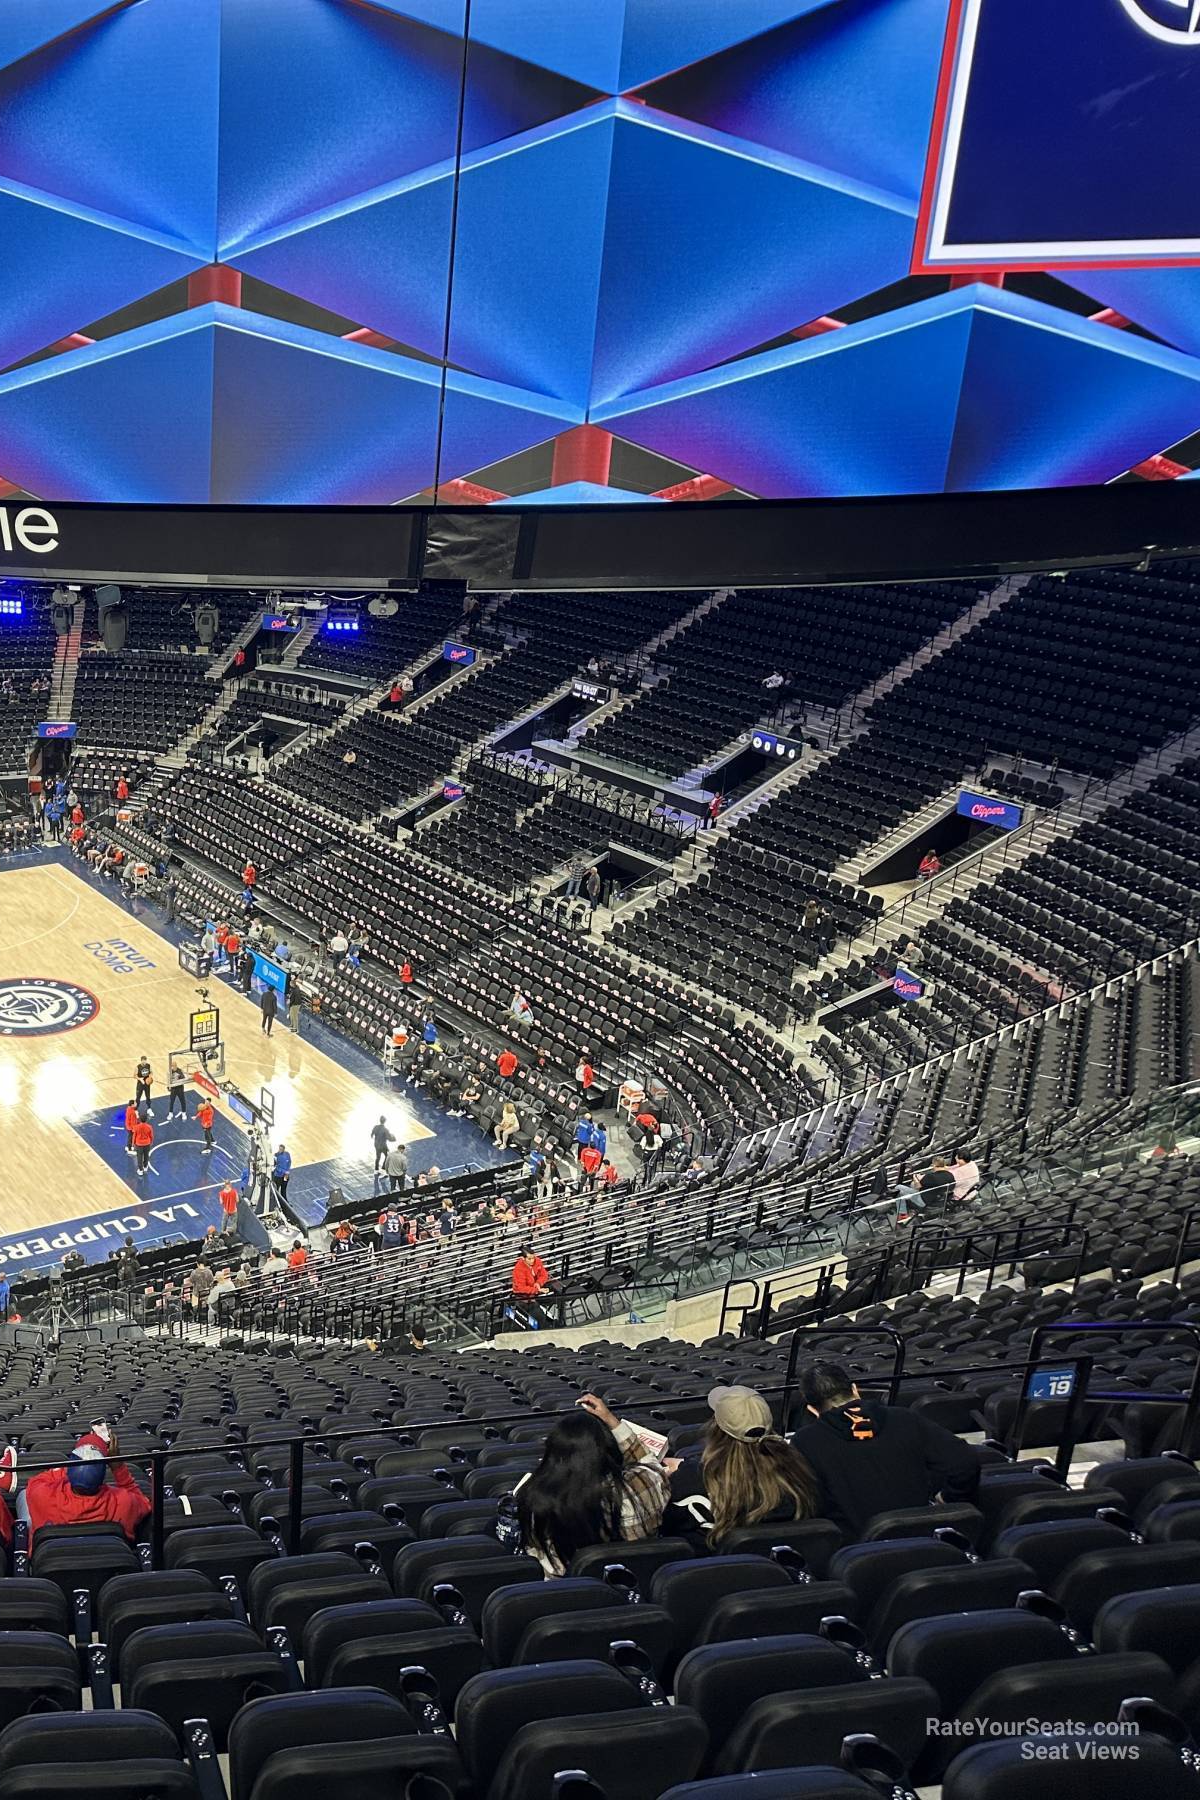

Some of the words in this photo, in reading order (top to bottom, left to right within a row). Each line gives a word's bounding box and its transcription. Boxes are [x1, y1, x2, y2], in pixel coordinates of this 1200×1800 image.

[971, 804, 1006, 818] Clippers
[21, 979, 59, 988] LOS
[65, 987, 94, 1027] ANGELES
[149, 1203, 200, 1223] LA
[386, 1222, 400, 1233] 33
[1049, 1381, 1071, 1396] 19
